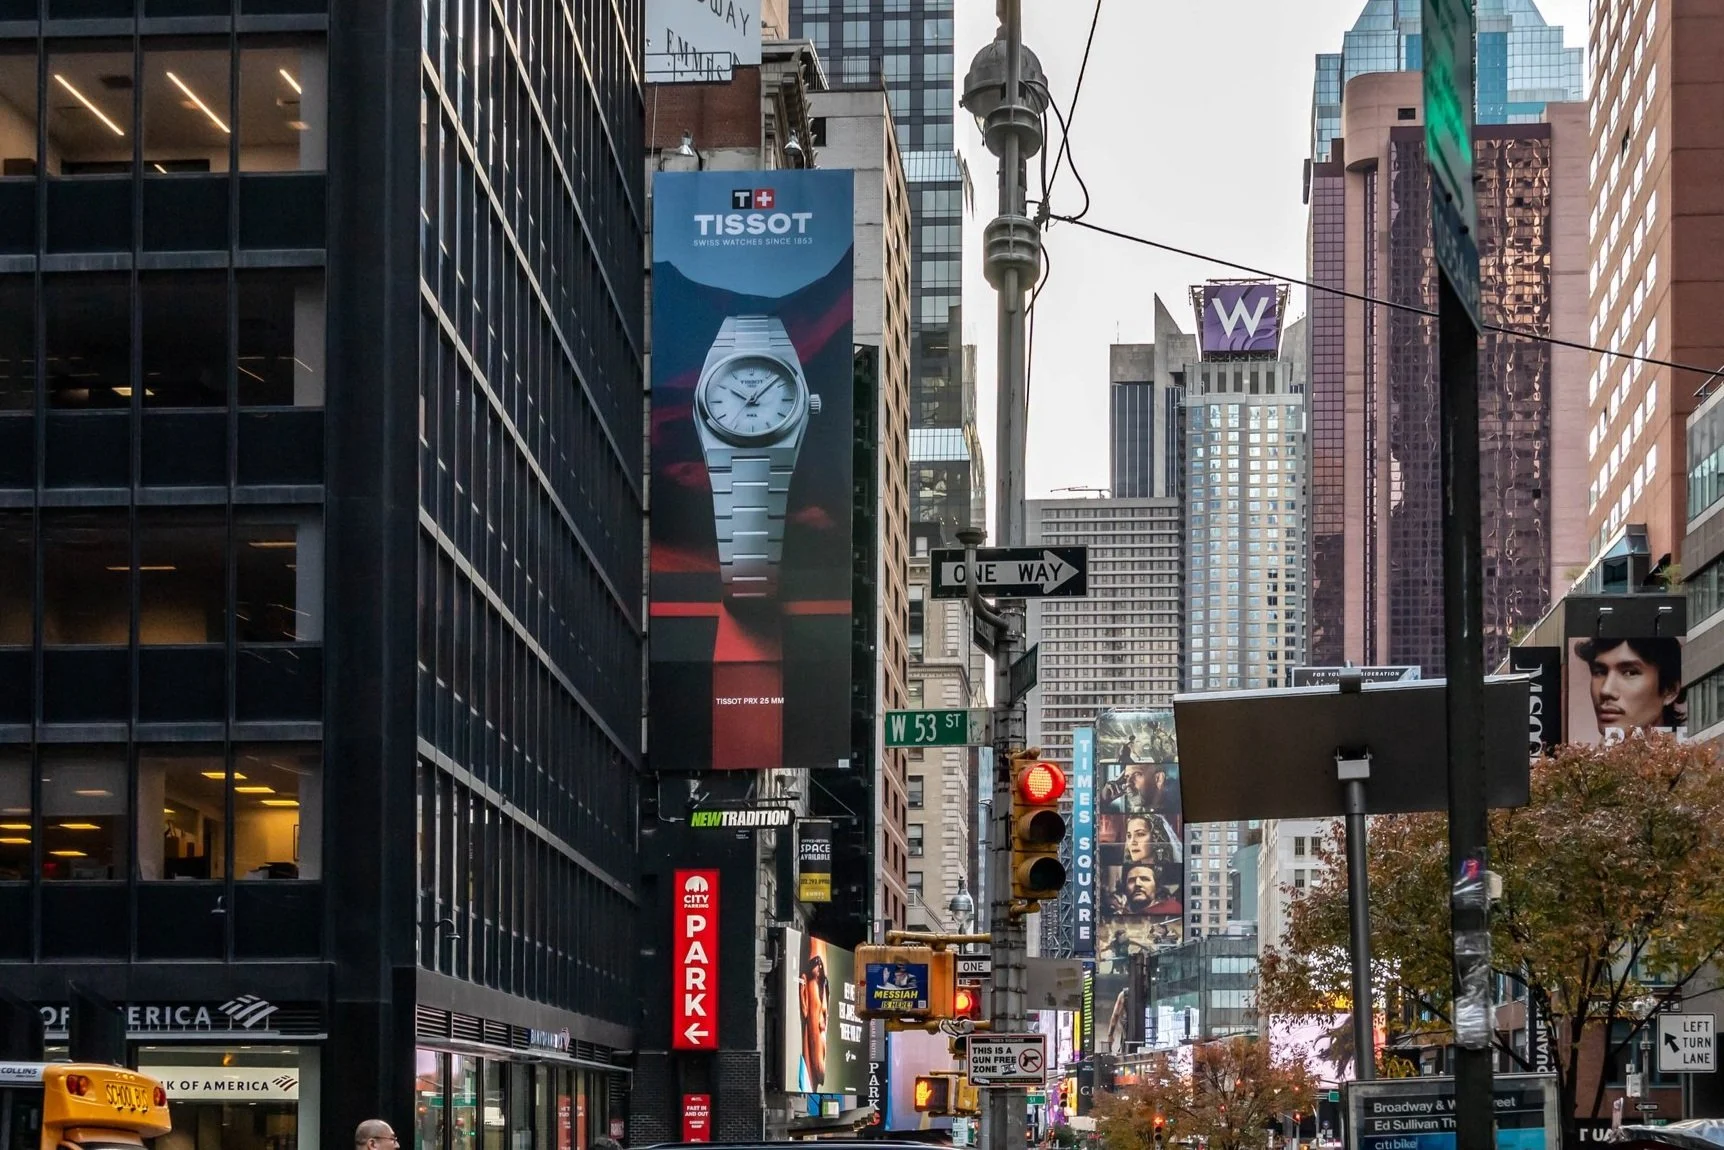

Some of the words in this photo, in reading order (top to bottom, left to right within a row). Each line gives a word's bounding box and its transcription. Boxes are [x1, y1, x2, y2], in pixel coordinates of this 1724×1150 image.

[693, 212, 813, 236] TISSOT
[693, 239, 720, 248] SWISS
[722, 238, 764, 247] WATCHES
[765, 238, 792, 246] SINCE
[1211, 296, 1270, 340] W
[953, 562, 997, 584] ONE
[1018, 562, 1064, 582] WAY
[1360, 670, 1401, 678] SIDERATION
[716, 697, 742, 706] TISSOT
[743, 697, 759, 705] PRX
[759, 697, 770, 705] 25
[891, 714, 907, 743] W
[915, 714, 938, 743] 53
[945, 713, 963, 728] ST
[1077, 739, 1092, 824] TIMES
[691, 809, 790, 827] NEWTRADITION
[800, 843, 831, 853] SPACE
[800, 853, 831, 861] AVAILABLE
[1076, 837, 1092, 941] SQUARE
[683, 894, 710, 904] CITY
[683, 914, 709, 1017] PARK
[962, 962, 984, 972] ONE
[873, 990, 919, 999] MESSIAH
[40, 1007, 70, 1026] OF
[117, 1006, 212, 1026] ERICA
[1683, 1020, 1710, 1033] LEFT
[1683, 1036, 1712, 1048] TURN
[972, 1046, 992, 1055] THIS
[995, 1046, 1004, 1054] IS
[1005, 1046, 1012, 1054] A
[972, 1055, 991, 1064] GUN
[994, 1055, 1017, 1064] FREE
[1683, 1052, 1711, 1064] LANE
[1, 1067, 37, 1075] COLLINS
[973, 1065, 997, 1073] ZONE
[180, 1080, 199, 1091] OF
[203, 1080, 269, 1092] AMERICA
[868, 1062, 881, 1111] PARK
[106, 1083, 135, 1107] SCHOOL
[134, 1087, 148, 1110] BUS
[1373, 1102, 1433, 1114] Broadway
[1436, 1101, 1445, 1111] &
[1494, 1097, 1516, 1107] reet
[1375, 1119, 1390, 1131] Ed
[1393, 1118, 1439, 1130] Sullivan
